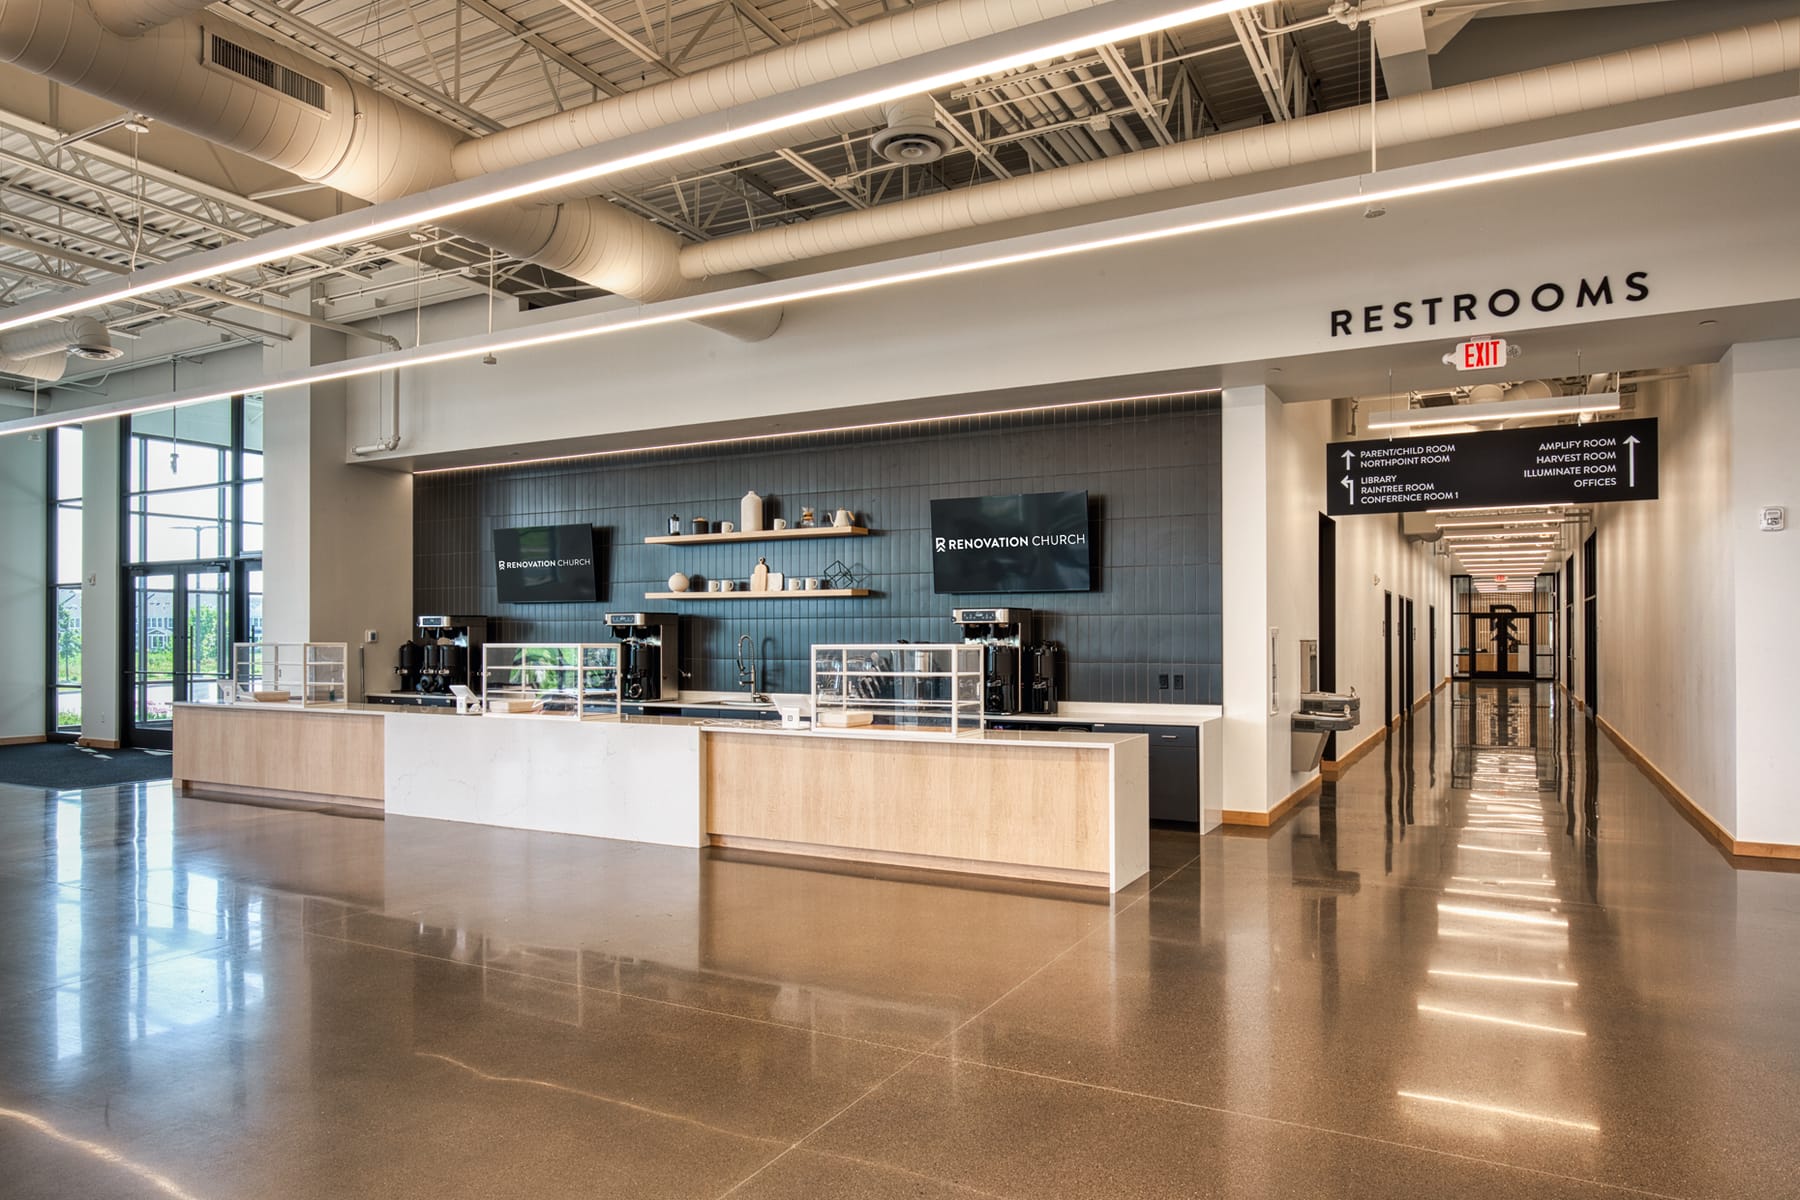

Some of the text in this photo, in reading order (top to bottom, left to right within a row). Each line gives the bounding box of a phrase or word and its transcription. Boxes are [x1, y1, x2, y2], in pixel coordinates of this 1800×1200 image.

[1331, 271, 1649, 337] RESTROOMS
[1464, 340, 1500, 368] EXIT
[1360, 444, 1456, 458] PARENT/CHILD ROOM
[1538, 438, 1617, 451] AMPLIFY ROOM
[1360, 454, 1451, 468] NORTHPOINT ROOM
[1536, 451, 1617, 464] HARVEST ROOM
[1523, 464, 1617, 478] ILLUMINATE ROOM
[1360, 474, 1397, 485] LIBRARY
[1573, 477, 1617, 488] OFFICES
[1360, 482, 1435, 495] RAINTREE ROOM
[1360, 491, 1459, 505] CONFERENCE ROOM 1
[948, 534, 1086, 550] RENOVATION CHURCH
[506, 558, 591, 569] RENOVATION CHURCH
